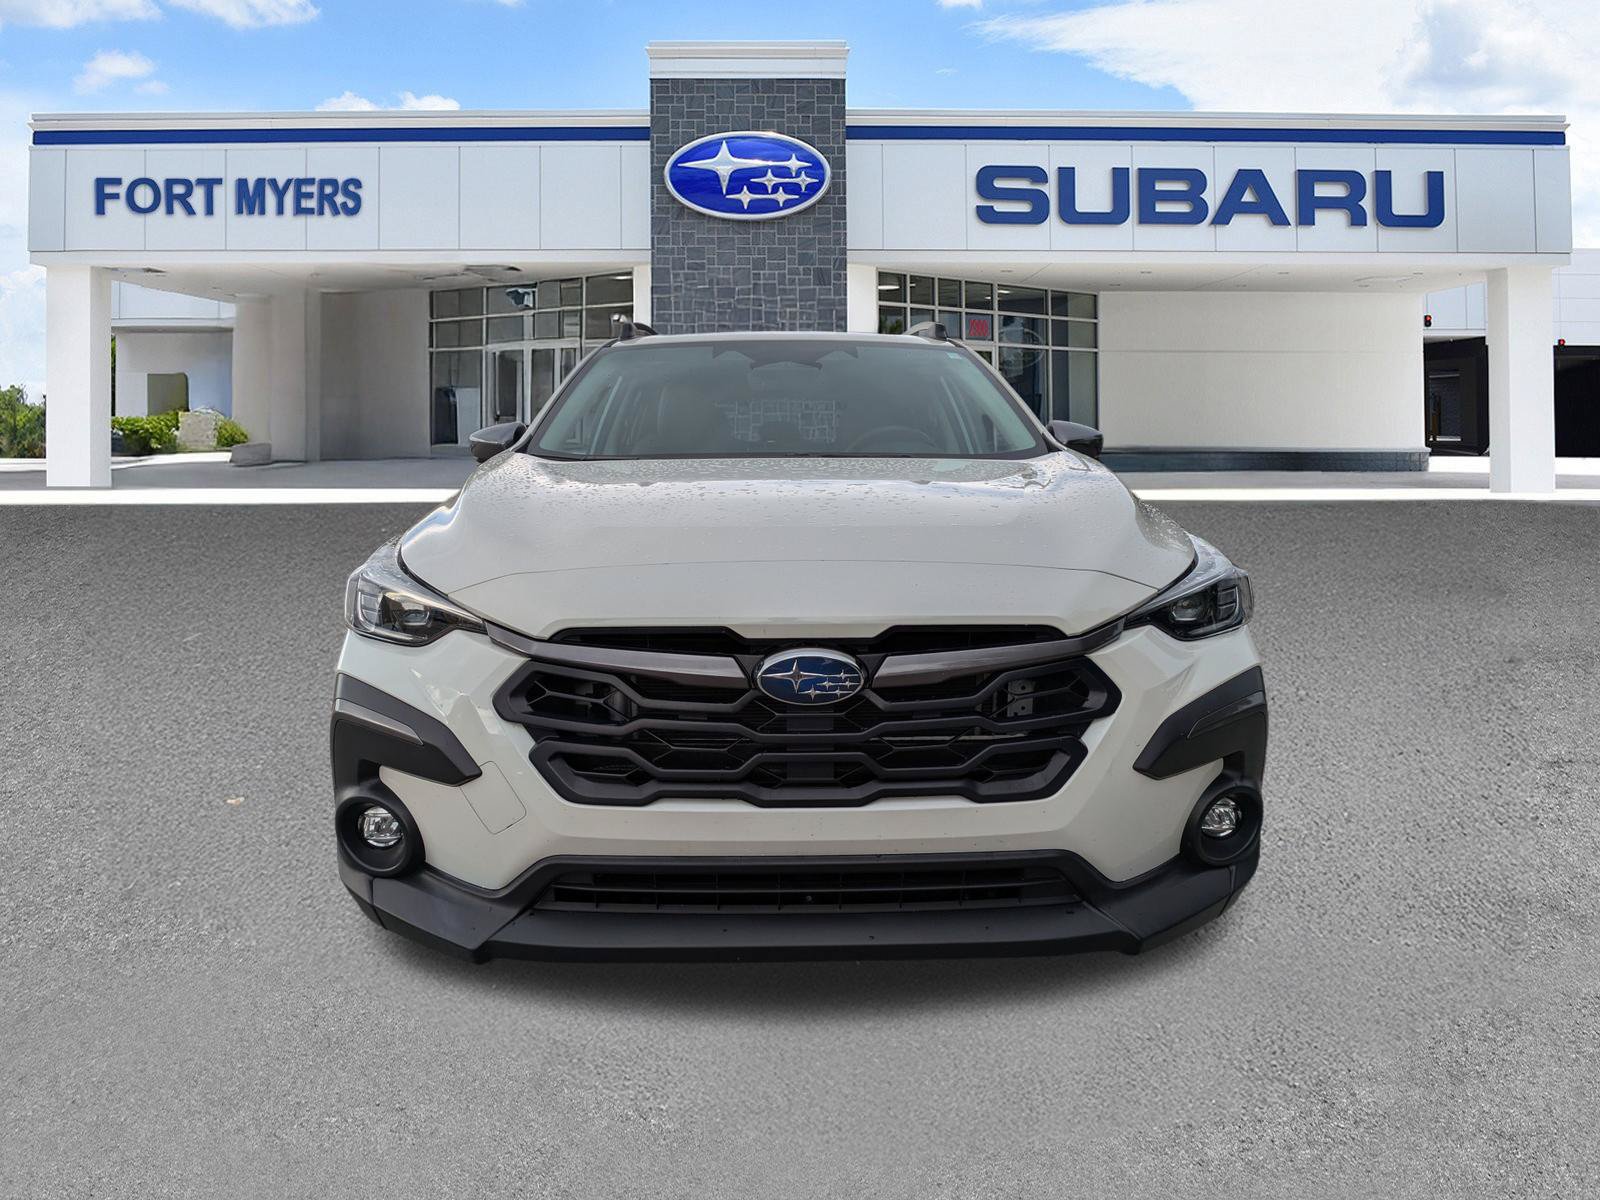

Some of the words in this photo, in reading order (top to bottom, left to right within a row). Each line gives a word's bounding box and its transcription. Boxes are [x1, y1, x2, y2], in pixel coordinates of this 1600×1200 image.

[94, 177, 224, 217] FORT
[235, 177, 363, 217] MYERS
[976, 165, 1446, 228] SUBARU
